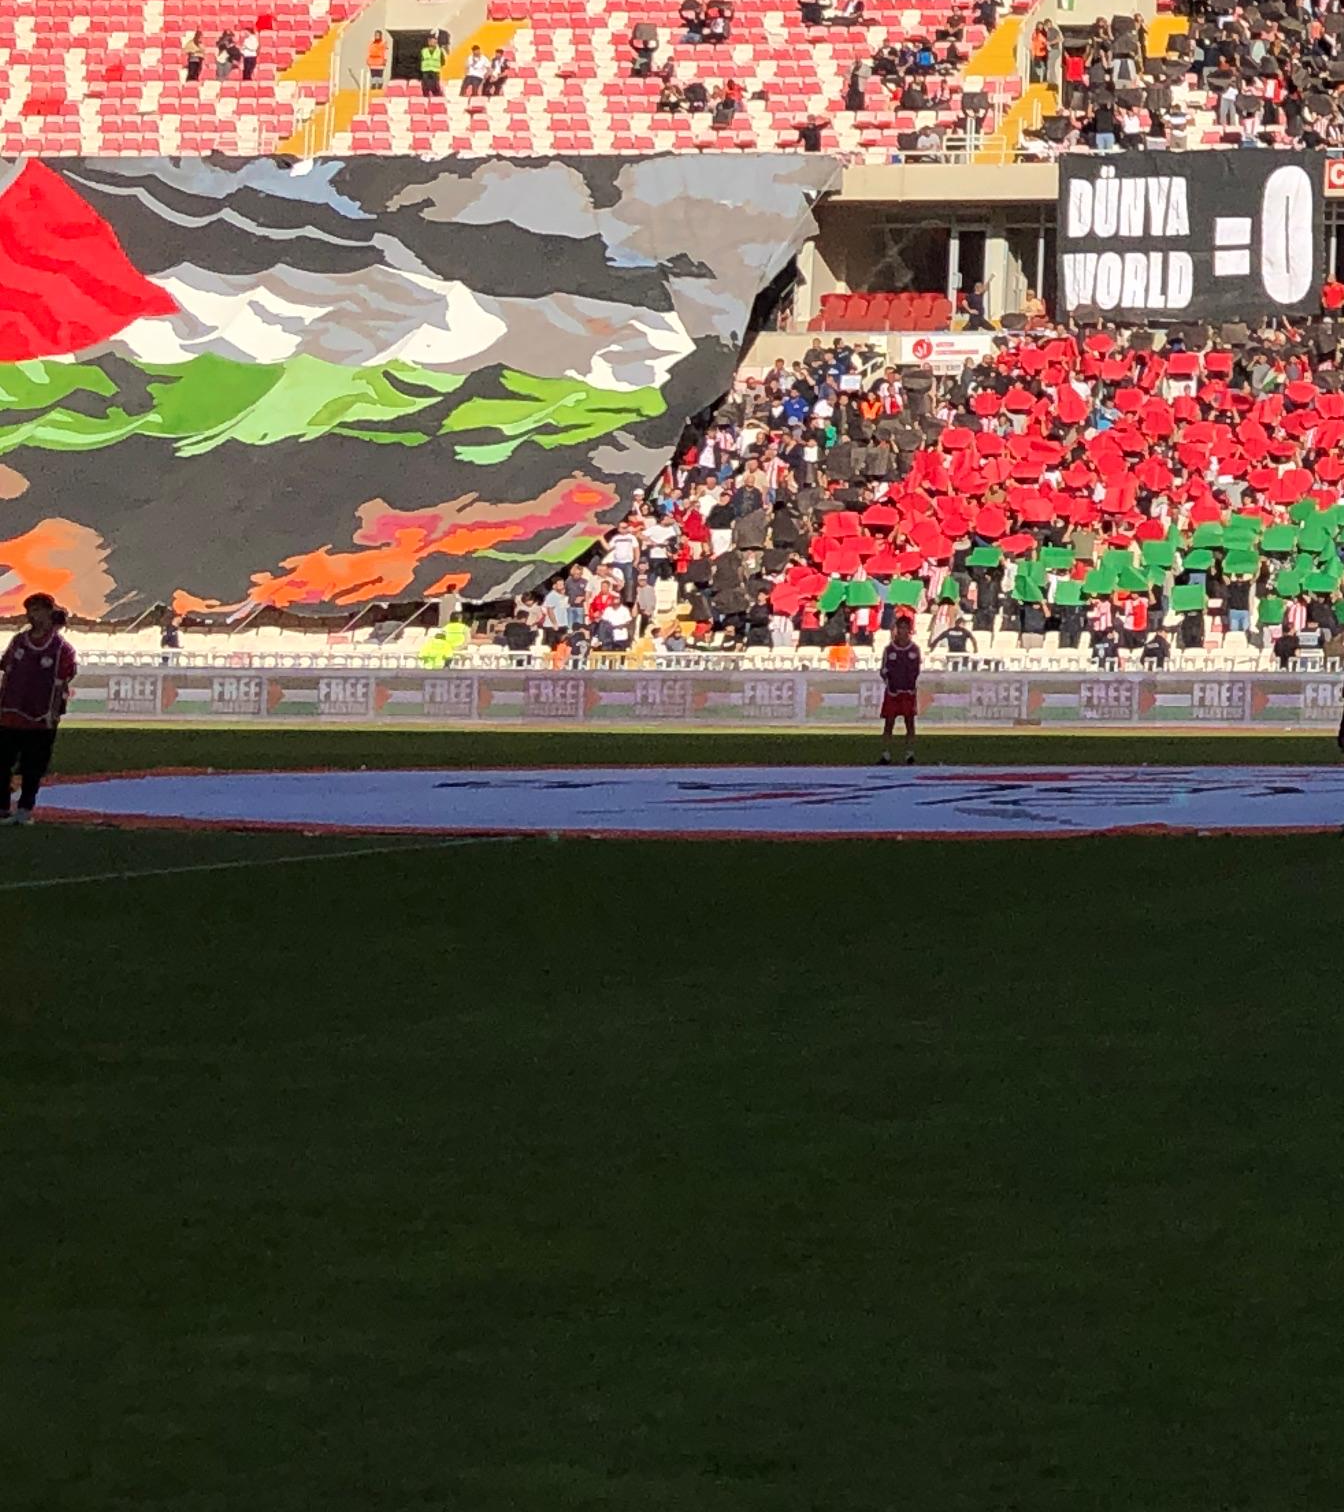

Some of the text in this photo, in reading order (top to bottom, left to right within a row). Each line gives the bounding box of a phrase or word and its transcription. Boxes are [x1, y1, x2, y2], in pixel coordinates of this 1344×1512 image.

[1067, 166, 1191, 239] DÜNYA
[1063, 250, 1194, 311] WORLD
[212, 678, 261, 702] FREE
[319, 679, 369, 702] FREE
[1193, 683, 1245, 706] FREE
